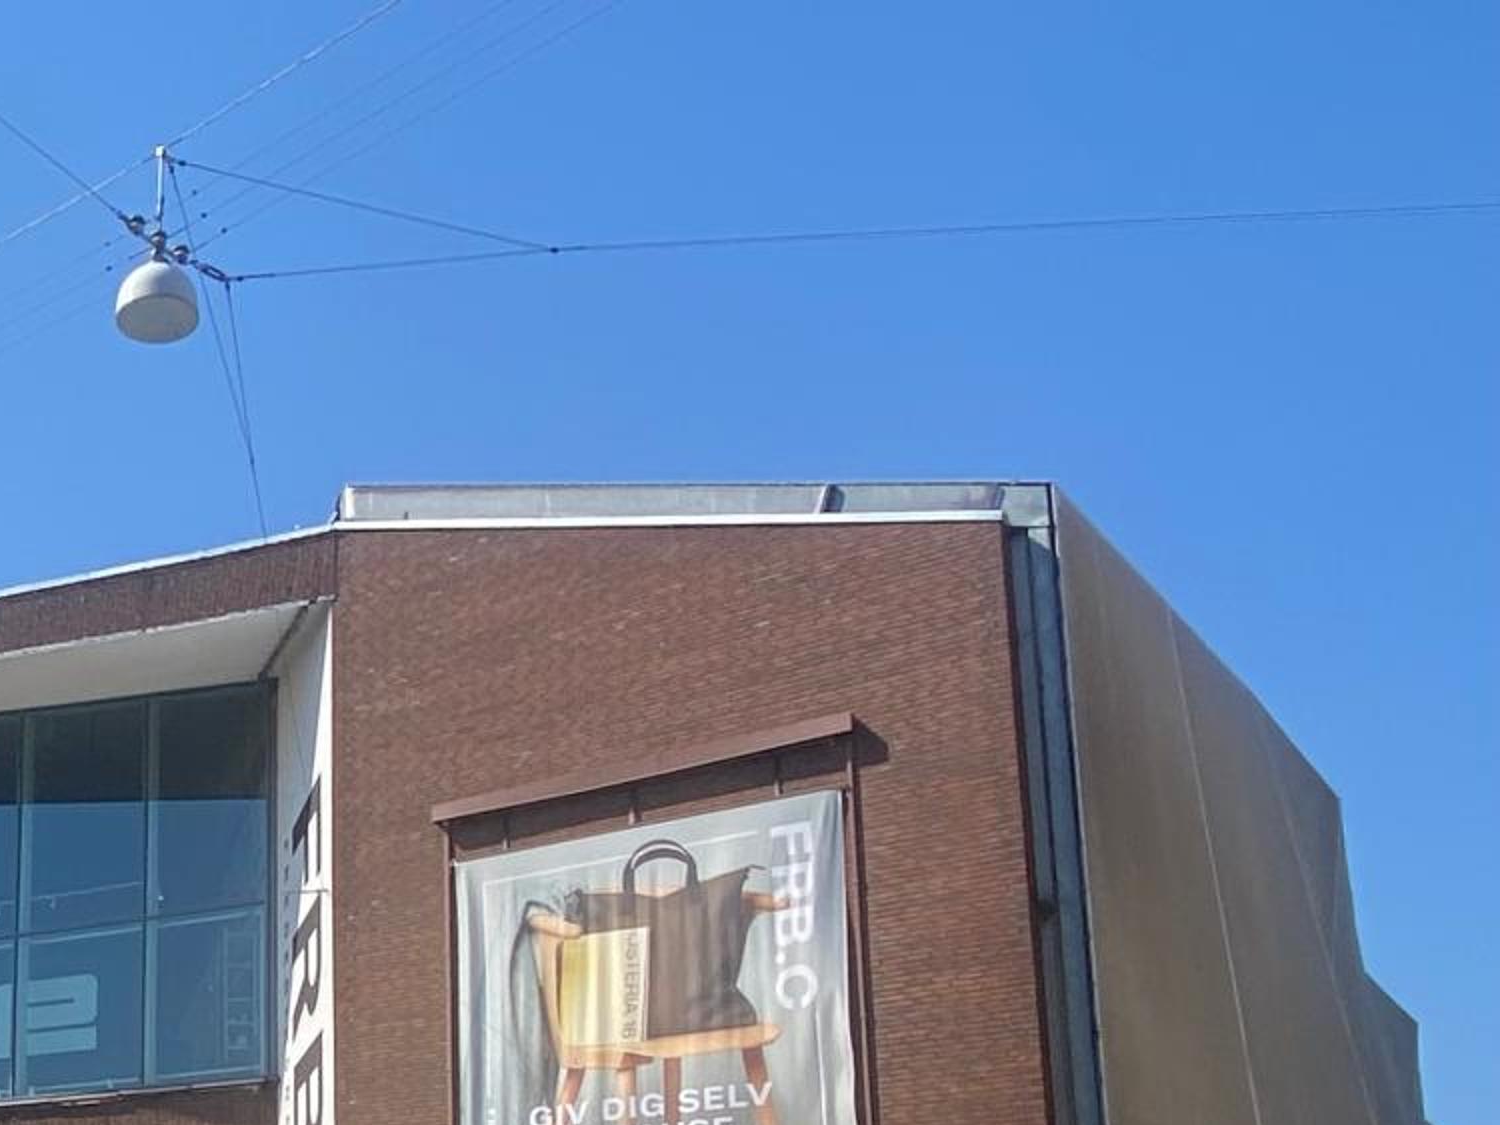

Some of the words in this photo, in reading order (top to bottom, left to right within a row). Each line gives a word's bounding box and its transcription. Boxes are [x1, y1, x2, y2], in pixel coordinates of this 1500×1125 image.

[770, 821, 818, 1010] FRB.C
[603, 1094, 665, 1121] DIG
[679, 1082, 772, 1113] SELV
